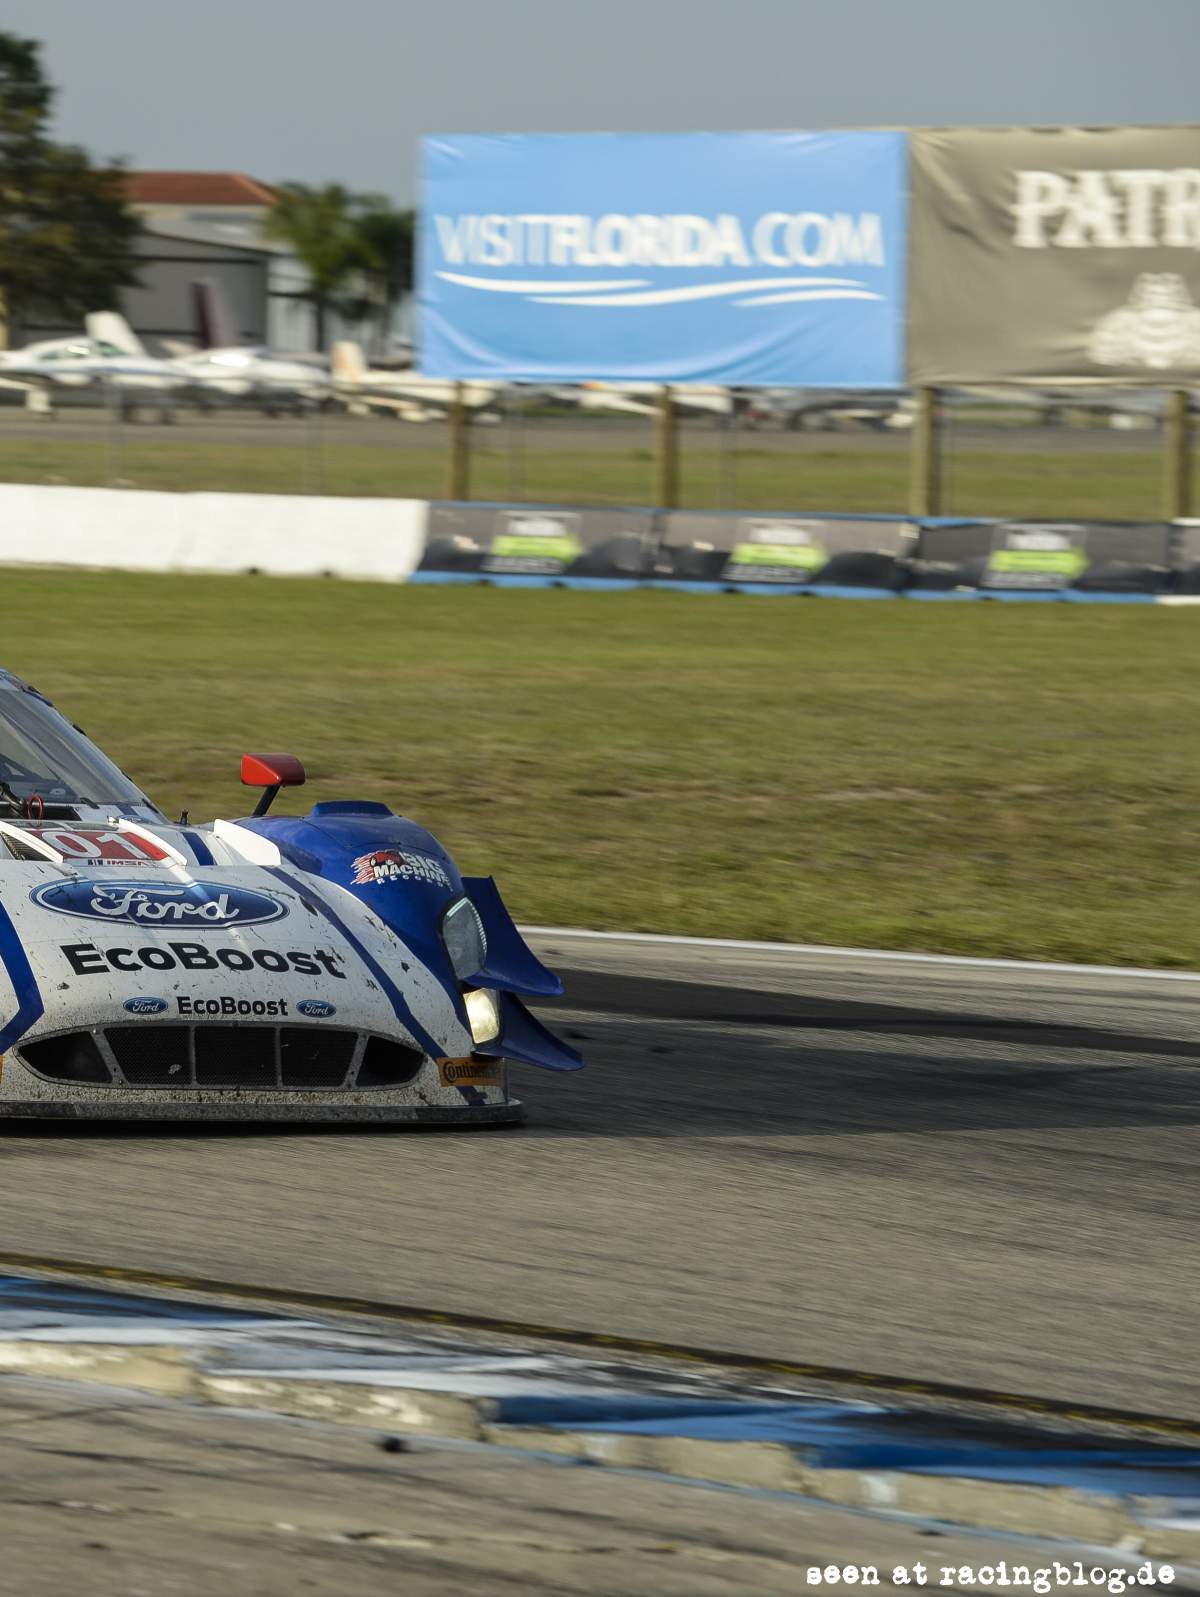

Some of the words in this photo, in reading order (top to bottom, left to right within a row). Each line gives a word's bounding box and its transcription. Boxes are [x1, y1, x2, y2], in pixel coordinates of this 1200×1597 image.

[42, 831, 148, 859] 01
[90, 884, 240, 920] Ford
[60, 942, 346, 979] EcoBoost
[132, 999, 160, 1013] Ford
[177, 996, 288, 1016] EcoBoost
[304, 1001, 330, 1016] Ford
